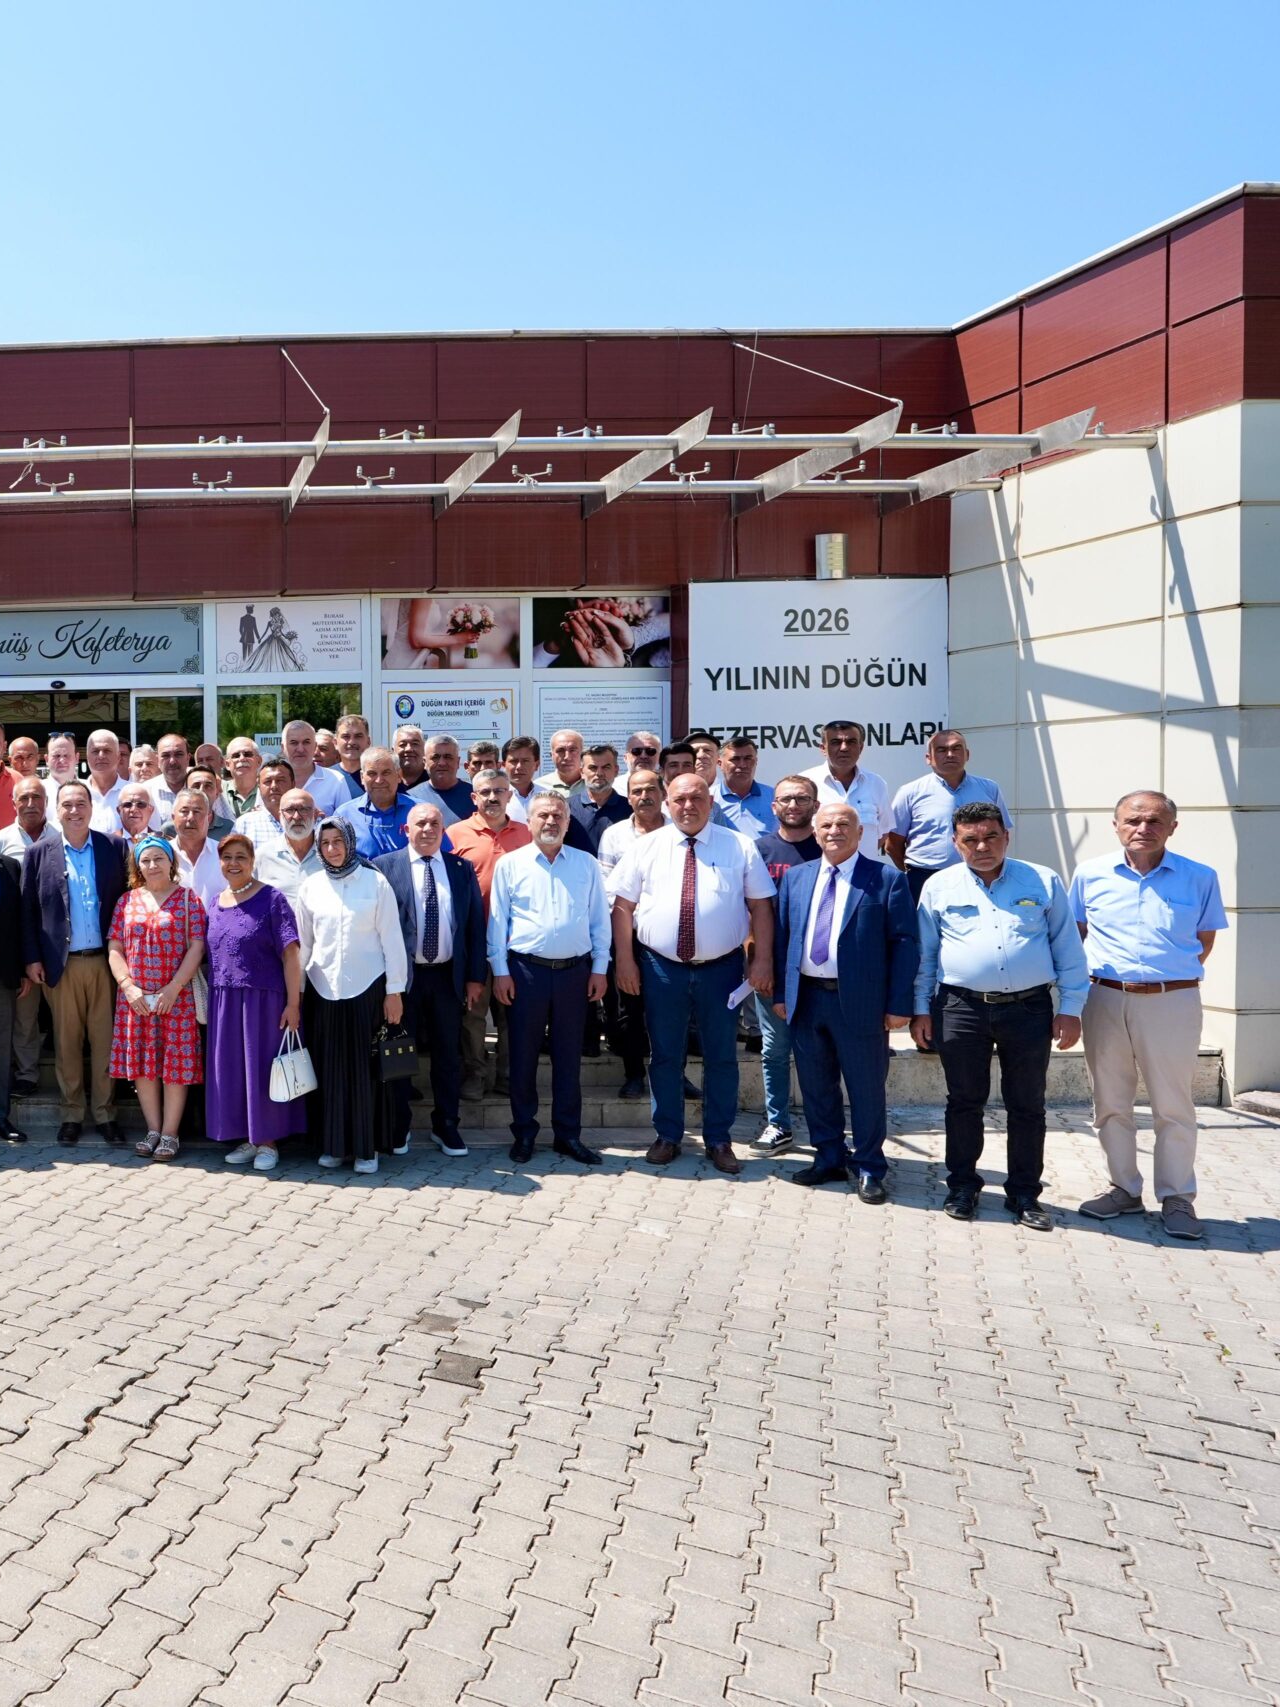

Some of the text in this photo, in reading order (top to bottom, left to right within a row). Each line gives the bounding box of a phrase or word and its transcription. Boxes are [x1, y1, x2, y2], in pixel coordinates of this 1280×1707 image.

[784, 608, 849, 632] 2026
[38, 618, 172, 665] Kafeterya
[704, 657, 927, 691] YILININ DÜĞÜN
[421, 698, 442, 707] DÜĞÜN
[261, 737, 282, 746] UNUT
